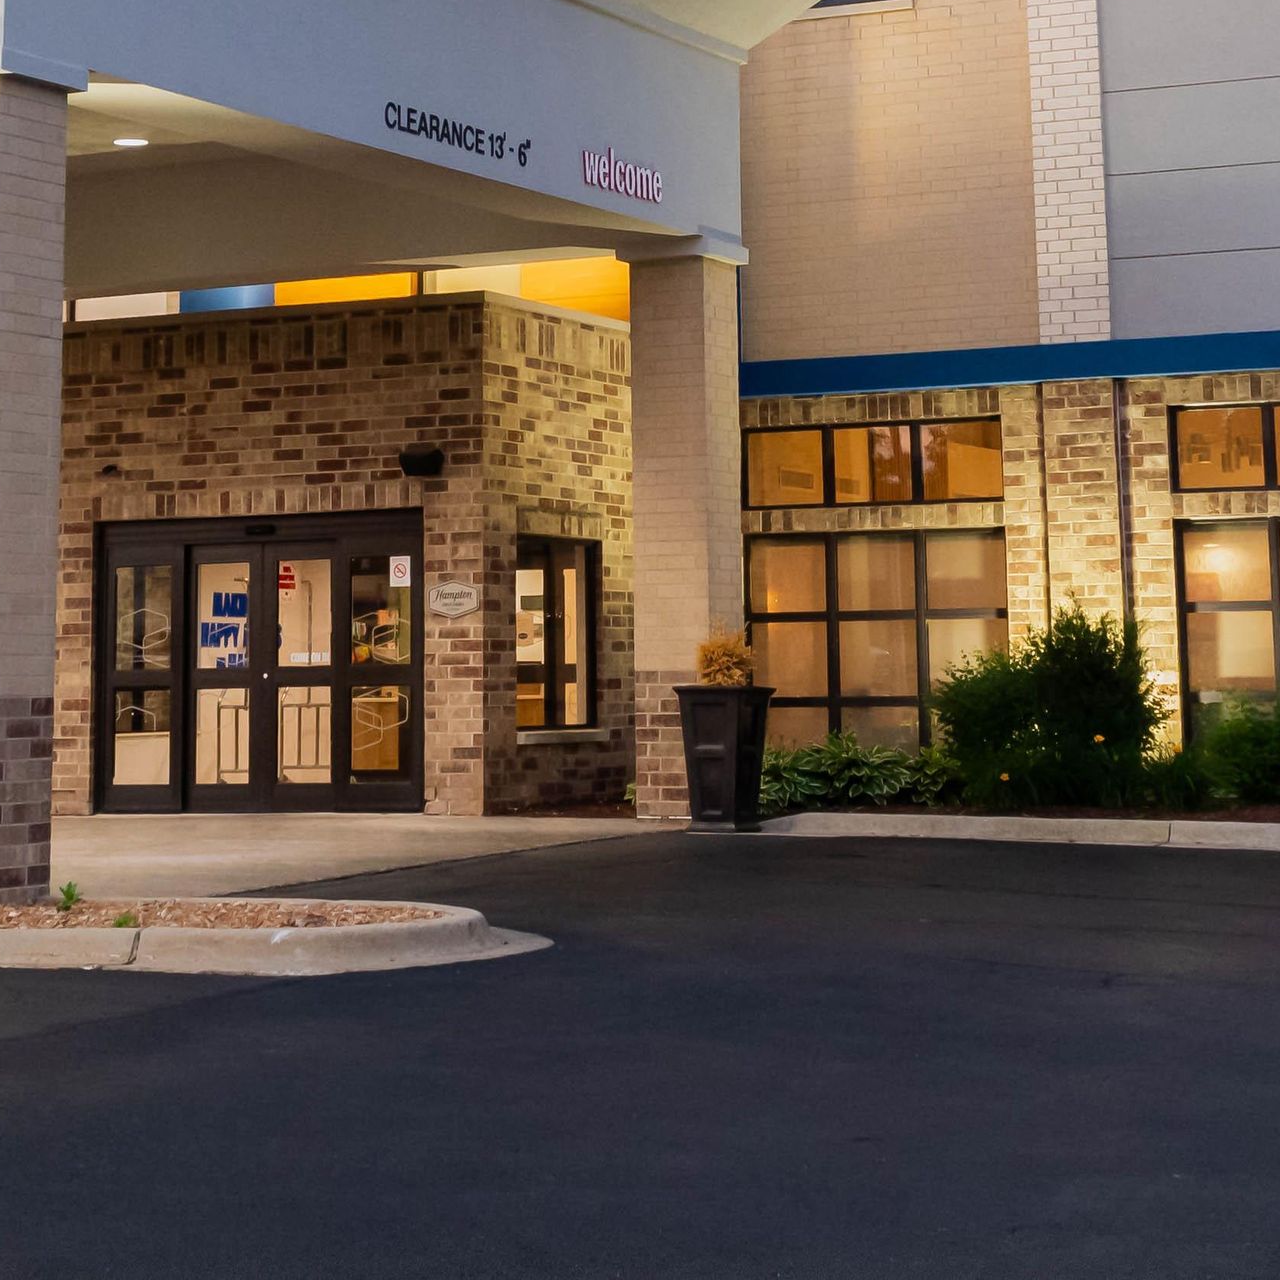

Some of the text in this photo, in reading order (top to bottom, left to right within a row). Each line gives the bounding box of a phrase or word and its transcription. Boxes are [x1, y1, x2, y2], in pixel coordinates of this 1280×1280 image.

[384, 101, 485, 156] CLEARANCE
[582, 146, 664, 204] welcome
[433, 589, 473, 603] Hampton
